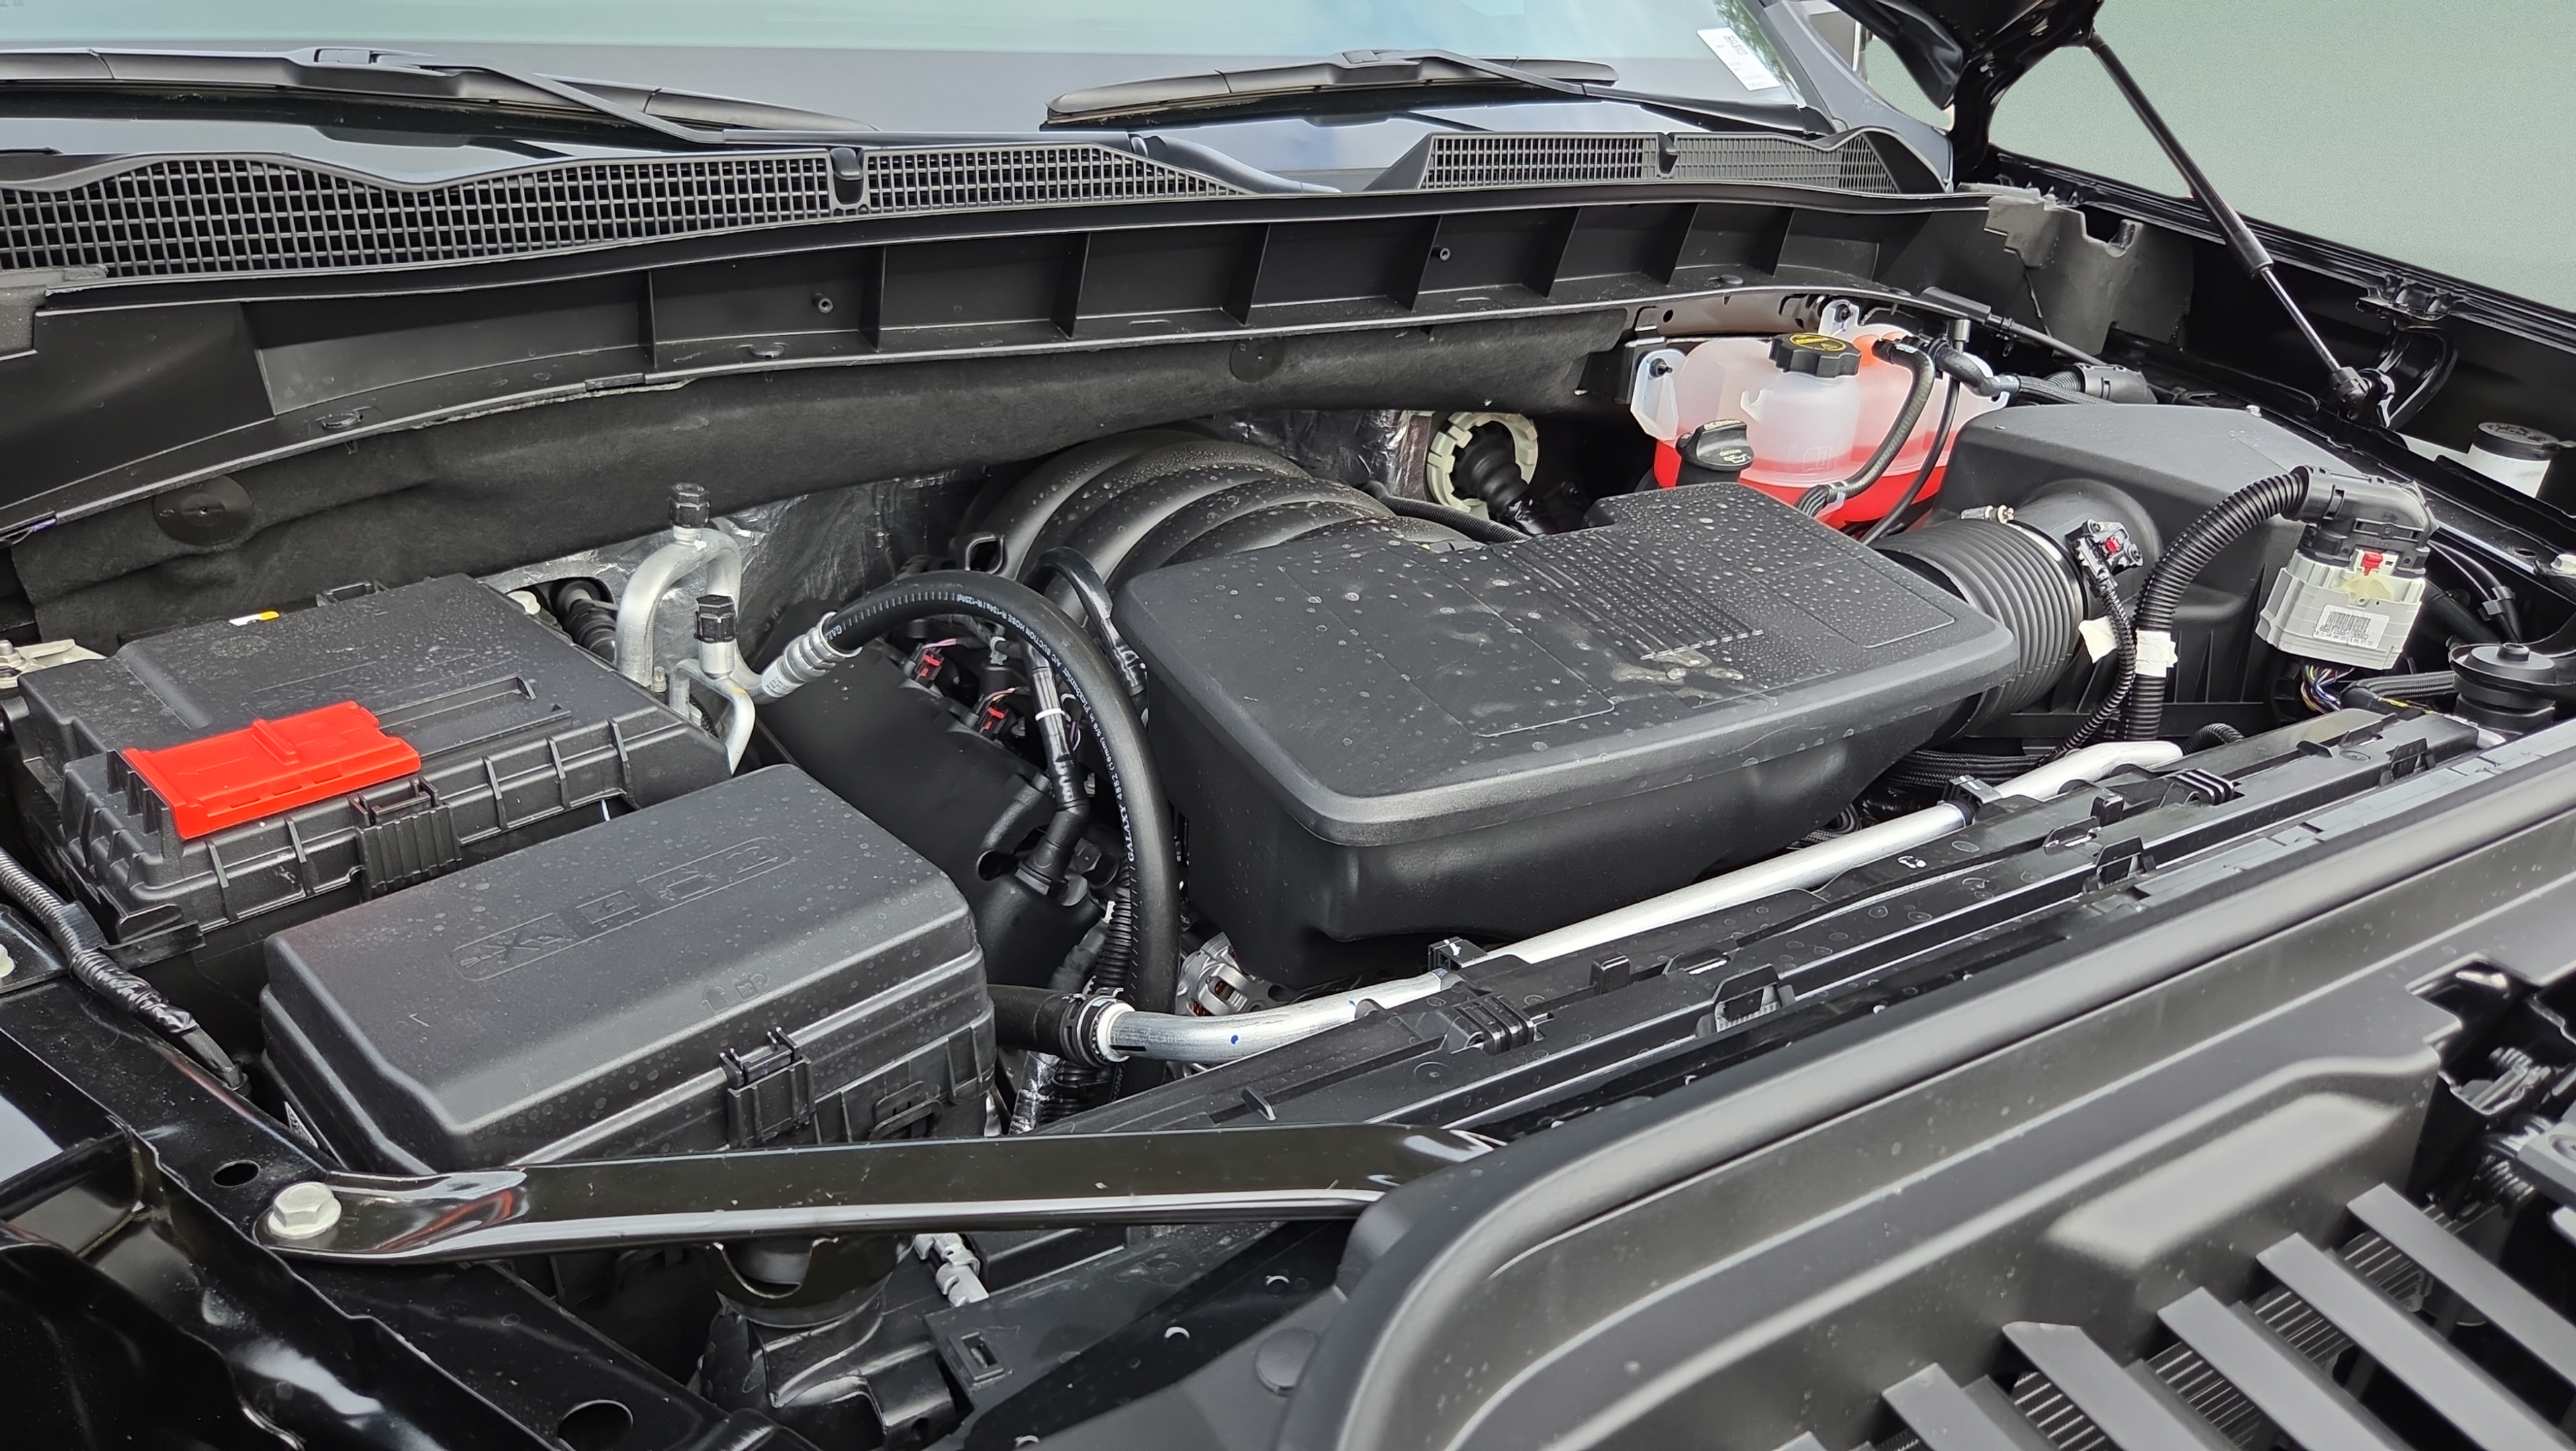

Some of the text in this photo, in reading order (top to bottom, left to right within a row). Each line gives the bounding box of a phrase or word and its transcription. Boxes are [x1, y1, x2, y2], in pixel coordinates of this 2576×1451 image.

[824, 625, 843, 640] GAL
[1007, 614, 1025, 631] HOSE
[1025, 627, 1052, 656] SUCTION
[1099, 737, 1115, 771] (16mm)
[1111, 773, 1123, 800] 4882
[1119, 804, 1135, 862] GALAXY
